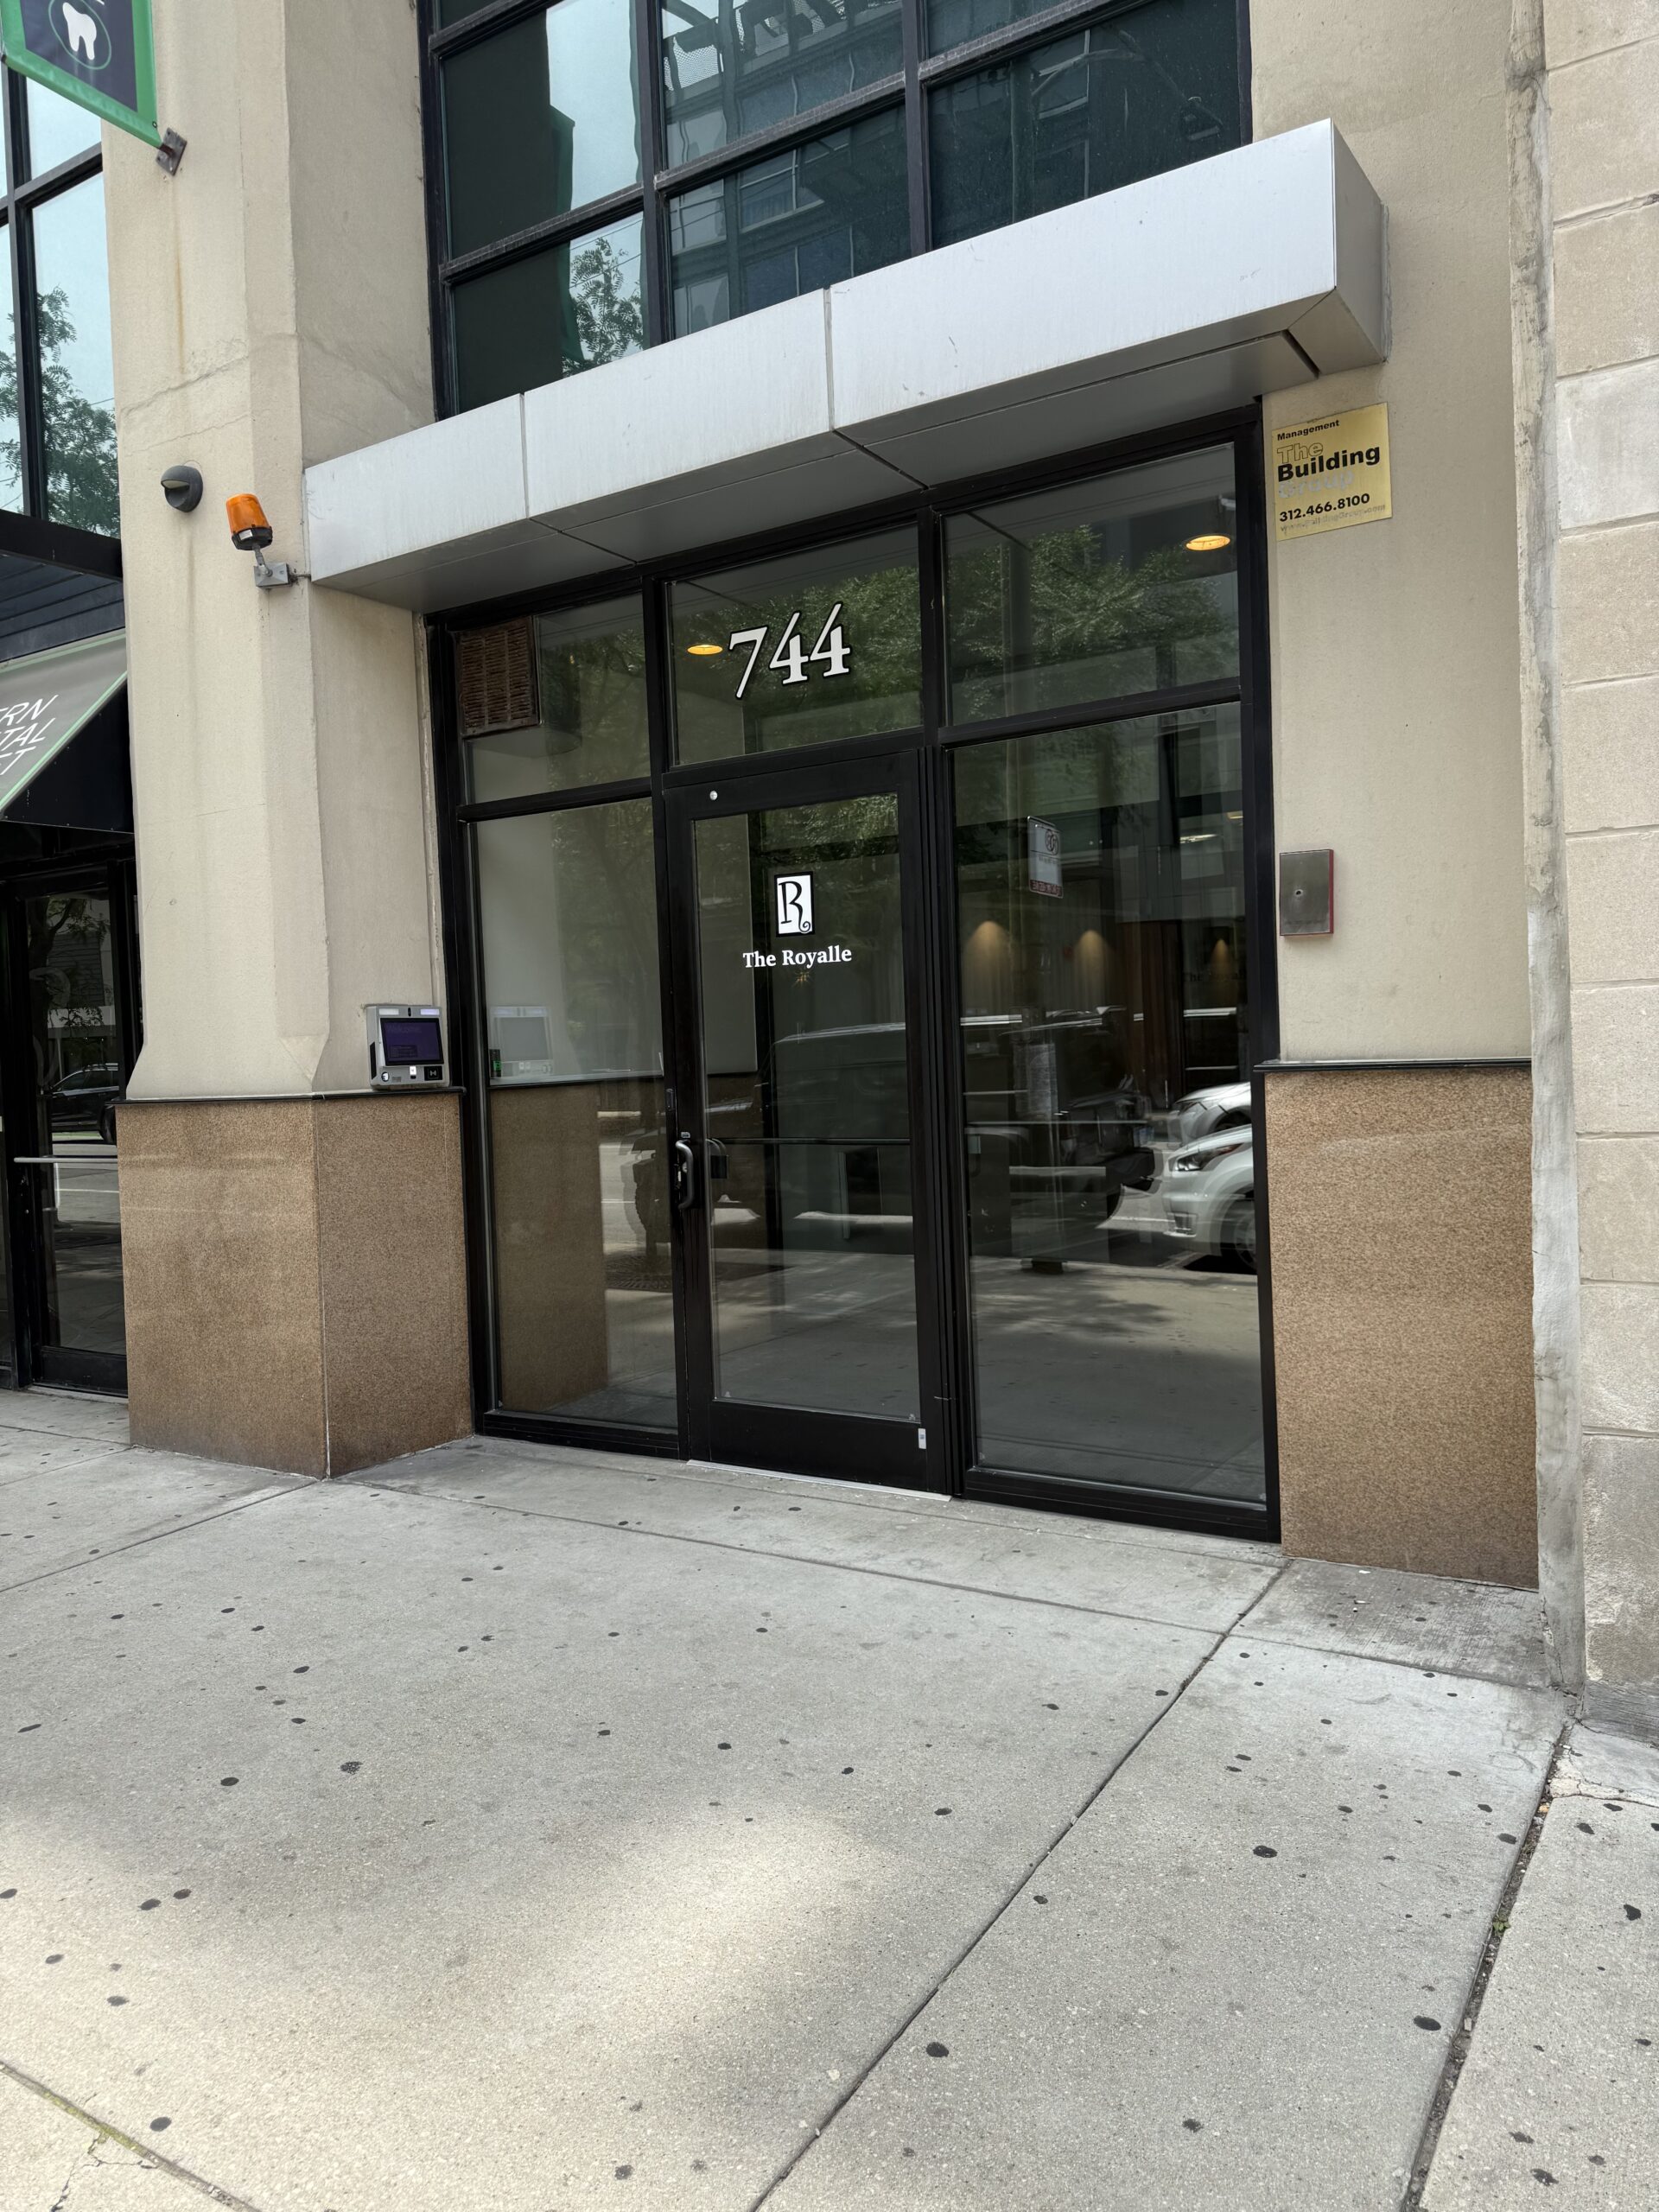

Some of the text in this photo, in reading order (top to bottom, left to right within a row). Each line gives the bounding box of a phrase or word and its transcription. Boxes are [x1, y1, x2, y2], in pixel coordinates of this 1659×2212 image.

[1277, 419, 1340, 441] Management
[1277, 442, 1324, 464] The
[1277, 446, 1381, 482] Building
[1277, 470, 1355, 499] Group
[1279, 493, 1370, 522] 312.466.8100
[728, 602, 851, 698] 744
[0, 695, 60, 727] RN
[778, 880, 811, 933] R
[742, 944, 853, 969] The Royalle
